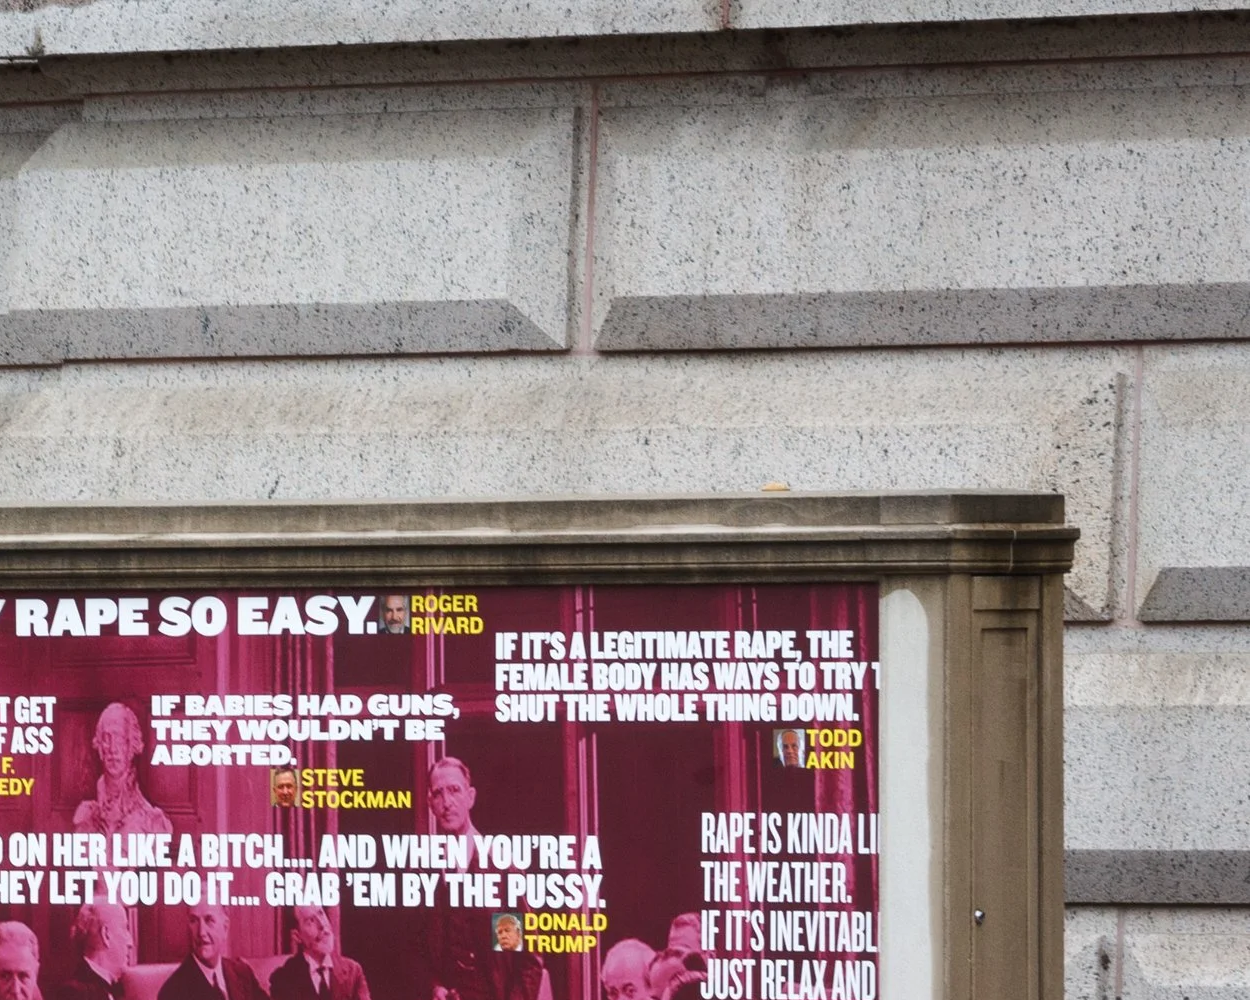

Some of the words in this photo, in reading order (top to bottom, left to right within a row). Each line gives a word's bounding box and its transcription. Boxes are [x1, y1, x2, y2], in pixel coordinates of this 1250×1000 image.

[16, 599, 148, 637] RAPE
[159, 597, 227, 637] SO
[238, 596, 377, 637] EASY.
[412, 595, 477, 612] ROGER
[412, 617, 483, 634] RIVARD
[496, 633, 517, 659] IF
[522, 632, 565, 660] IT'S
[570, 632, 586, 659] A
[591, 631, 730, 659] LEGITIMATE
[735, 631, 801, 660] RAPE,
[806, 631, 853, 658] THE
[496, 663, 588, 690] FEMALE
[593, 663, 656, 690] BODY
[662, 662, 709, 690] HAS
[713, 662, 779, 690] WAYS
[784, 662, 816, 691] TO
[820, 662, 867, 689] TRY
[15, 696, 56, 723] GET
[152, 696, 180, 716] IF
[185, 695, 292, 716] BABIES
[298, 695, 362, 715] HAD
[368, 694, 459, 716] GUNS,
[495, 694, 559, 722] SHUT
[563, 694, 610, 721] THE
[615, 694, 698, 721] WHOLE
[702, 693, 776, 721] THING
[782, 693, 858, 721] DOWN.
[11, 727, 53, 754] ASS
[152, 720, 232, 740] THEY
[237, 720, 399, 741] WOULDN'T
[405, 720, 444, 740] BE
[806, 729, 861, 747] TODD
[151, 745, 296, 765] ABORTED.
[806, 752, 854, 769] AKIN
[302, 769, 364, 786] STEVE
[302, 791, 411, 808] STOCKMAN
[702, 813, 755, 853] RAPE
[761, 813, 781, 853] IS
[788, 813, 852, 854] KINDA
[9, 833, 46, 866] ON
[53, 834, 107, 866] HER
[113, 833, 171, 866] LIKE
[178, 834, 195, 867] A
[319, 835, 376, 868] AND
[382, 835, 468, 868] WHEN
[473, 835, 576, 869] YOU'RE
[582, 835, 601, 869] A
[50, 871, 98, 904] LET
[103, 871, 157, 905] YOU
[164, 872, 201, 905] DO
[266, 872, 339, 906] GRAB
[403, 873, 439, 906] BY
[445, 873, 501, 907] THE
[508, 874, 605, 908] PUSSY.
[701, 862, 741, 902] THE
[747, 862, 851, 902] WEATHER.
[525, 913, 607, 931] DONALD
[702, 910, 720, 950] IF
[726, 910, 764, 951] IT'S
[770, 911, 880, 952] INEVITABL
[525, 935, 596, 952] TRUMP
[701, 959, 755, 999] JUST
[761, 960, 826, 1000] RELAX
[832, 961, 875, 1000] AND
